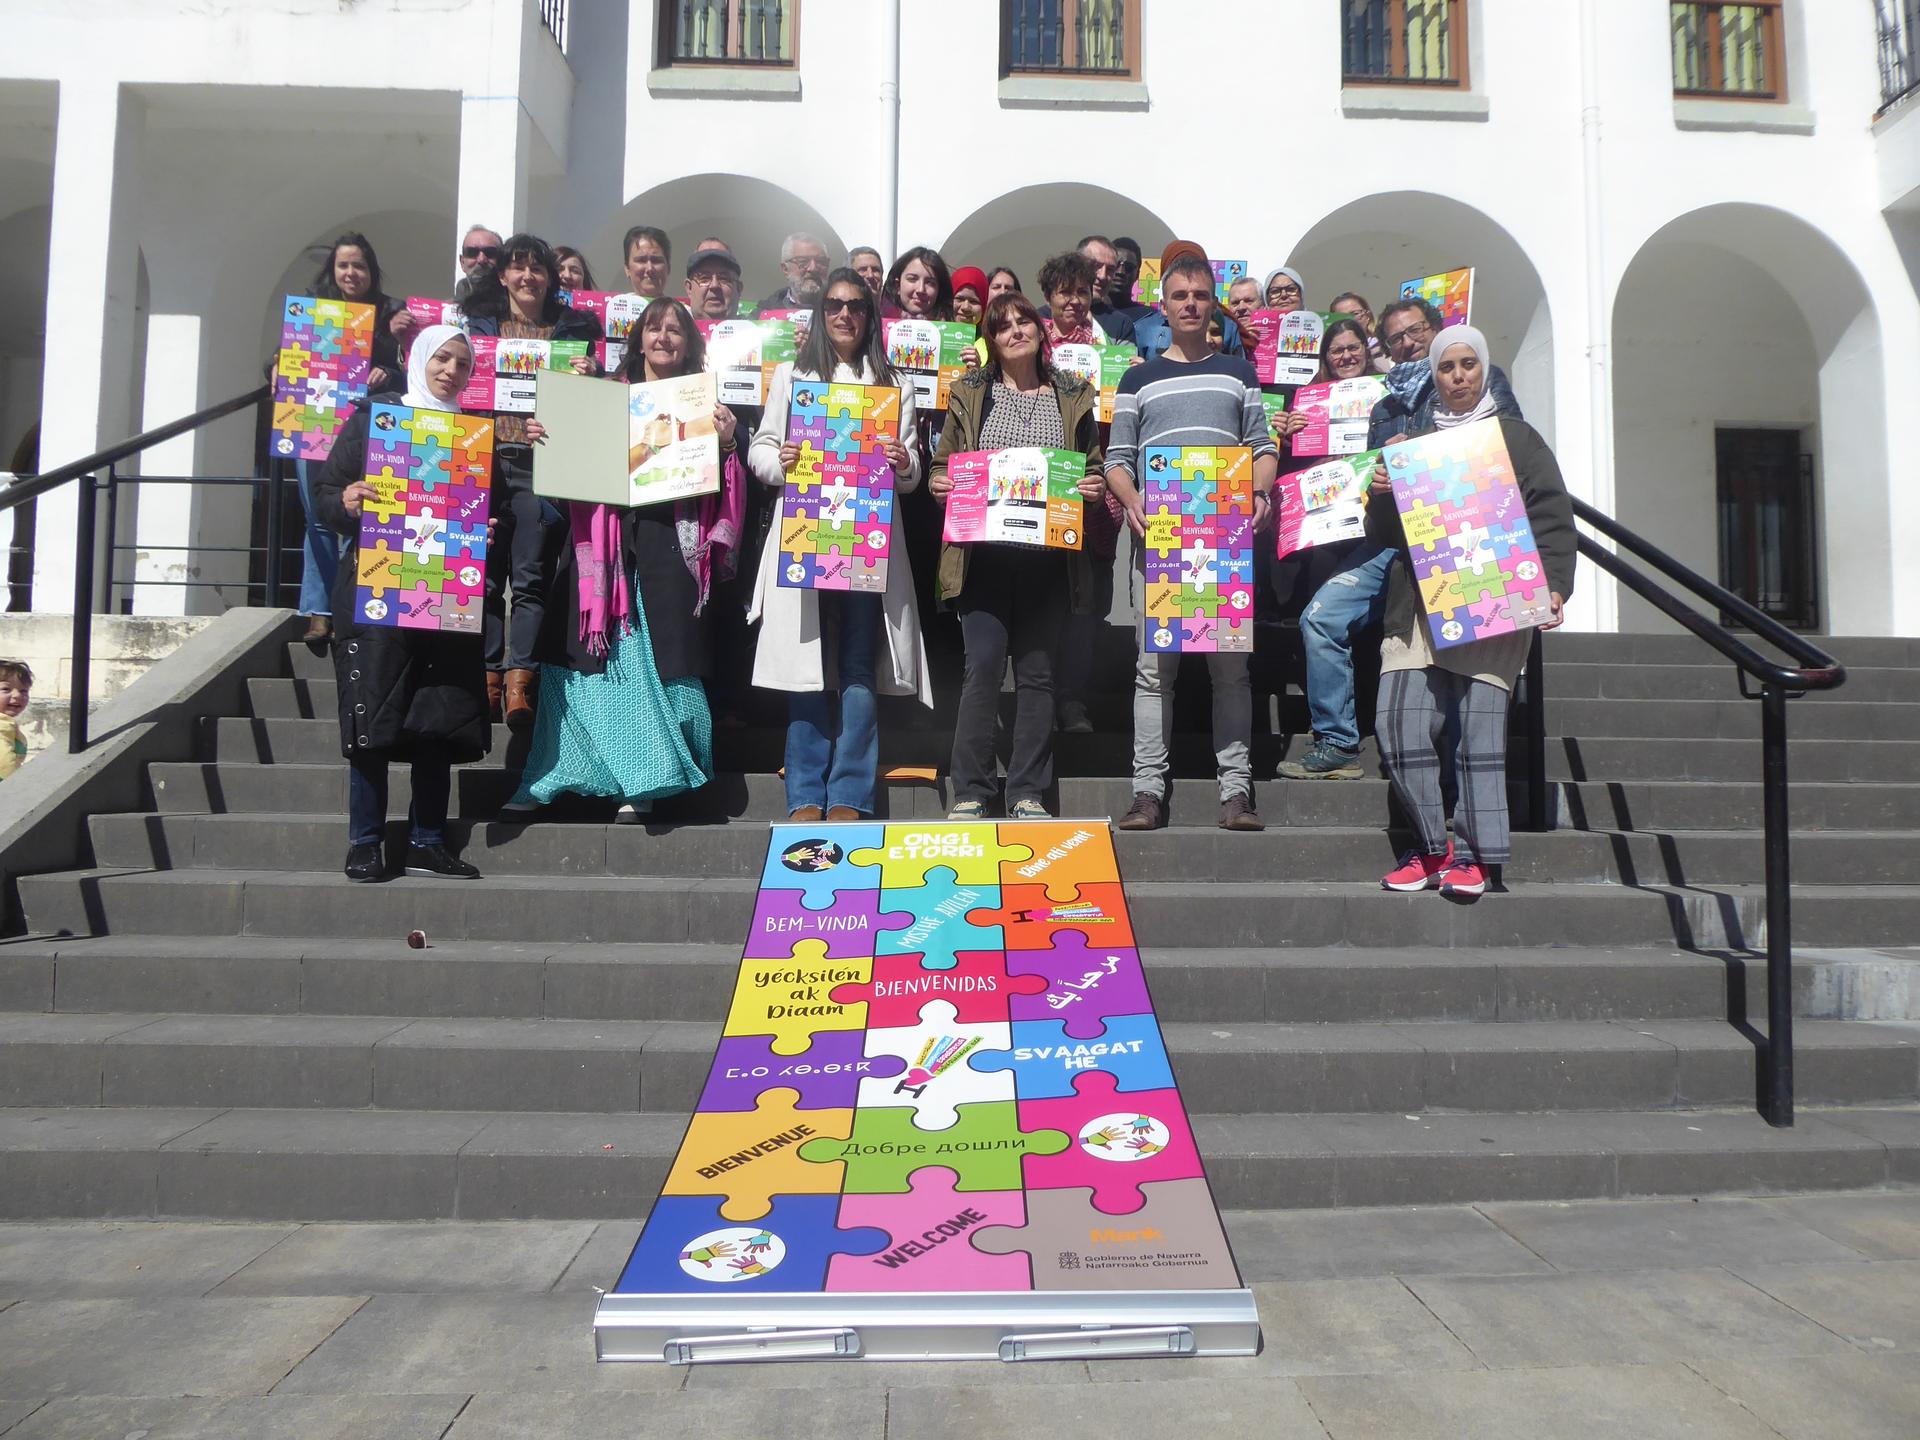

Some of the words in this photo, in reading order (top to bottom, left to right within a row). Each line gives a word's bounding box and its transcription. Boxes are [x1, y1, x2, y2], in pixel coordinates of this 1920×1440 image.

[408, 492, 446, 505] BIENVENIDAS
[1060, 830, 1095, 850] venit
[934, 888, 981, 918] AVILEN
[790, 986, 820, 1001] ak
[875, 975, 997, 997] BIENVENIDAS
[767, 1003, 844, 1019] Diaam
[1014, 1040, 1143, 1060] SVAAGAT
[1064, 1056, 1098, 1070] HE
[696, 1123, 816, 1179] BIENVENUE
[841, 1141, 926, 1156] Добре
[935, 1139, 1025, 1153] дошли
[872, 1207, 988, 1269] WELCOME
[1086, 1261, 1150, 1269] Nafarroako
[1152, 1259, 1208, 1267] Gobernua
[1140, 1253, 1153, 1261] de
